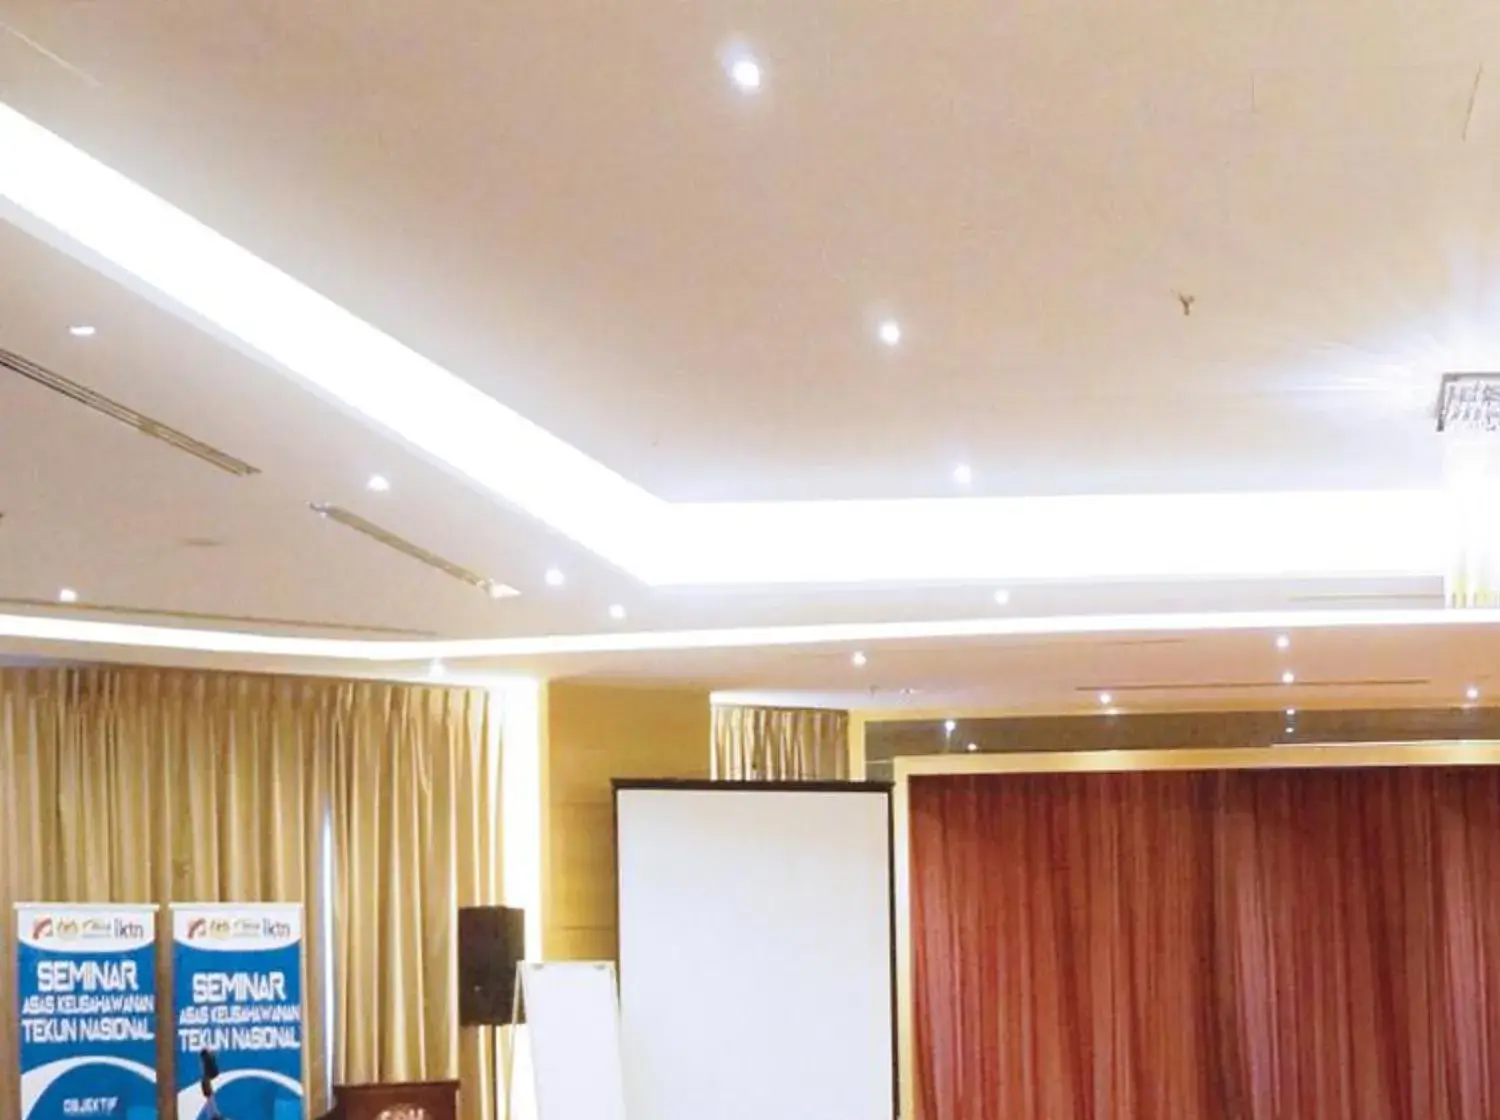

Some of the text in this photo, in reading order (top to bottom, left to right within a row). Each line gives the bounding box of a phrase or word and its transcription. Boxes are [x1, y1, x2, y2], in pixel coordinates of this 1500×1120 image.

[37, 960, 139, 992] SEMINAR
[192, 970, 286, 1003] SEMINAR
[21, 1016, 155, 1043] TEKUN NASIONAL
[178, 1026, 300, 1052] TEKUN NASIONAL
